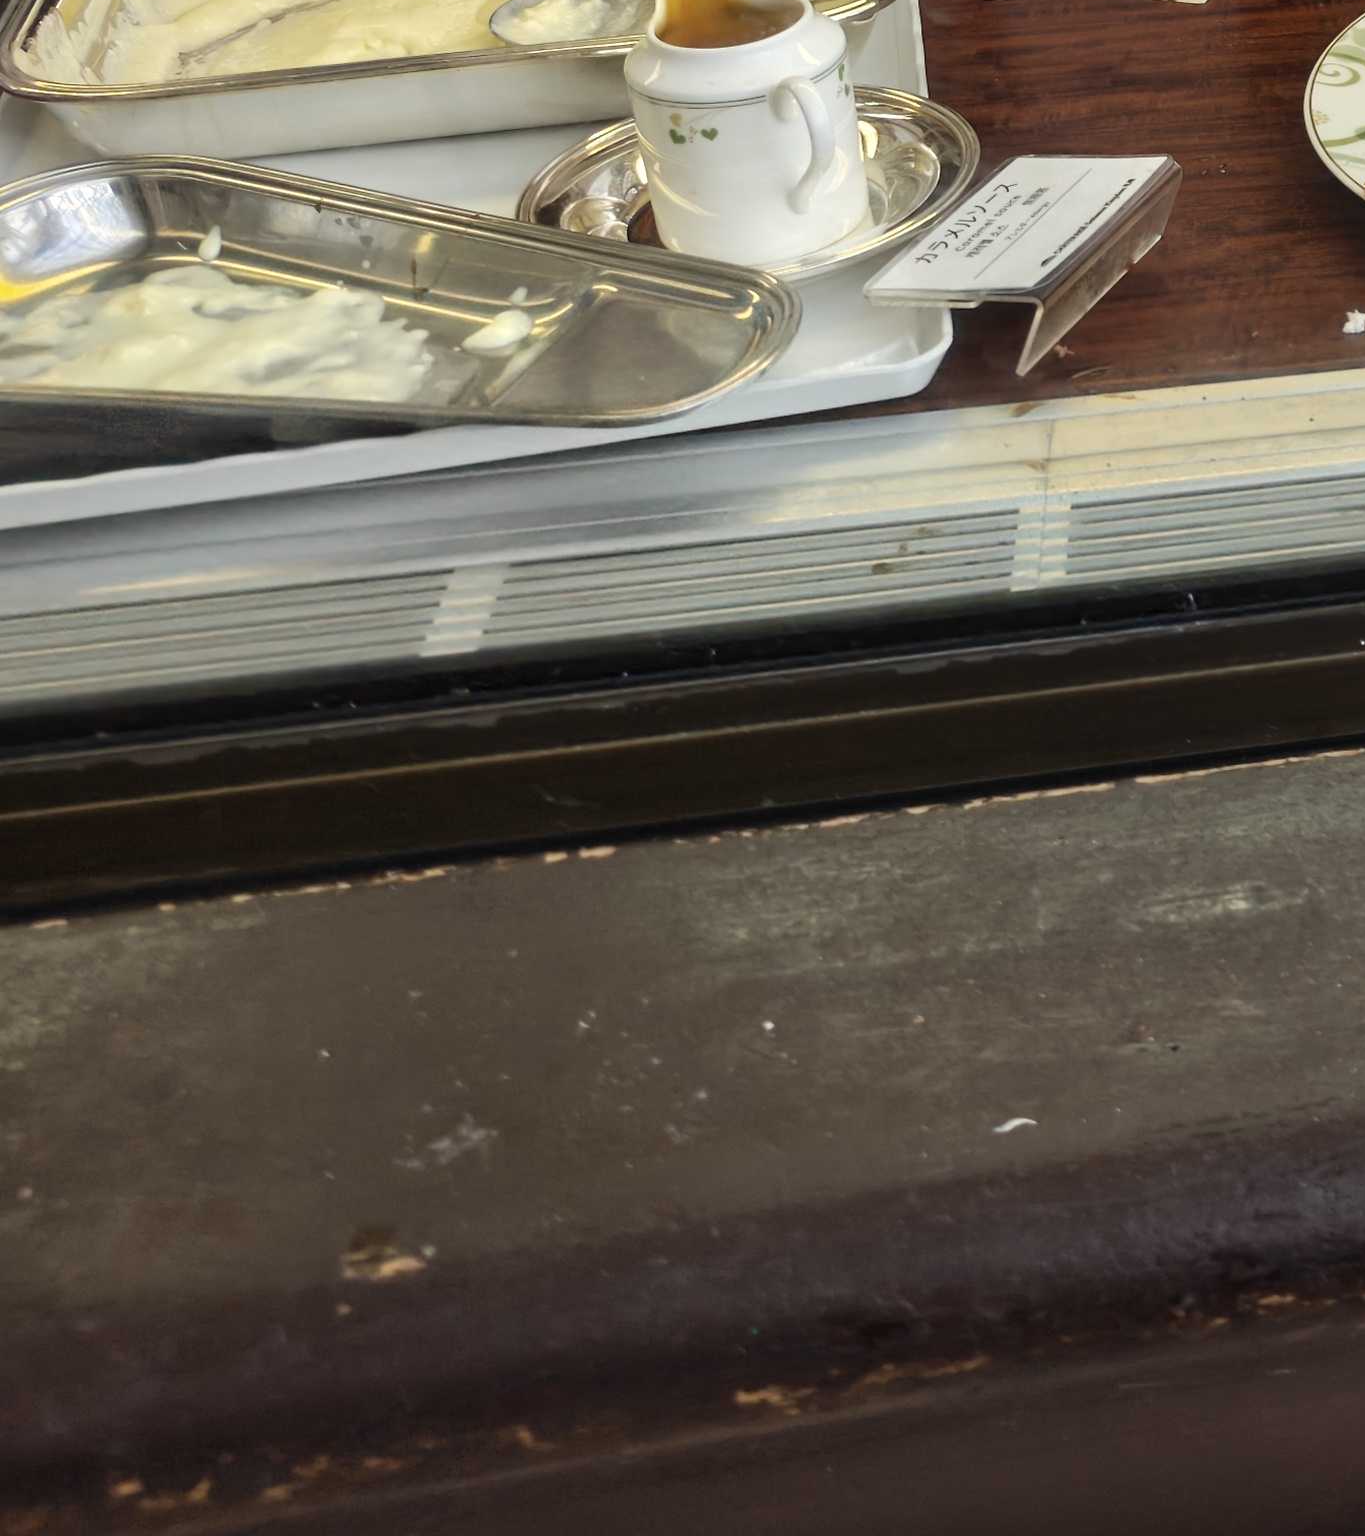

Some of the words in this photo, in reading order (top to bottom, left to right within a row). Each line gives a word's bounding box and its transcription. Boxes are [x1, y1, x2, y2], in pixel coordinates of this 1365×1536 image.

[914, 182, 1019, 264] カラメルソース
[954, 218, 996, 253] Caramel
